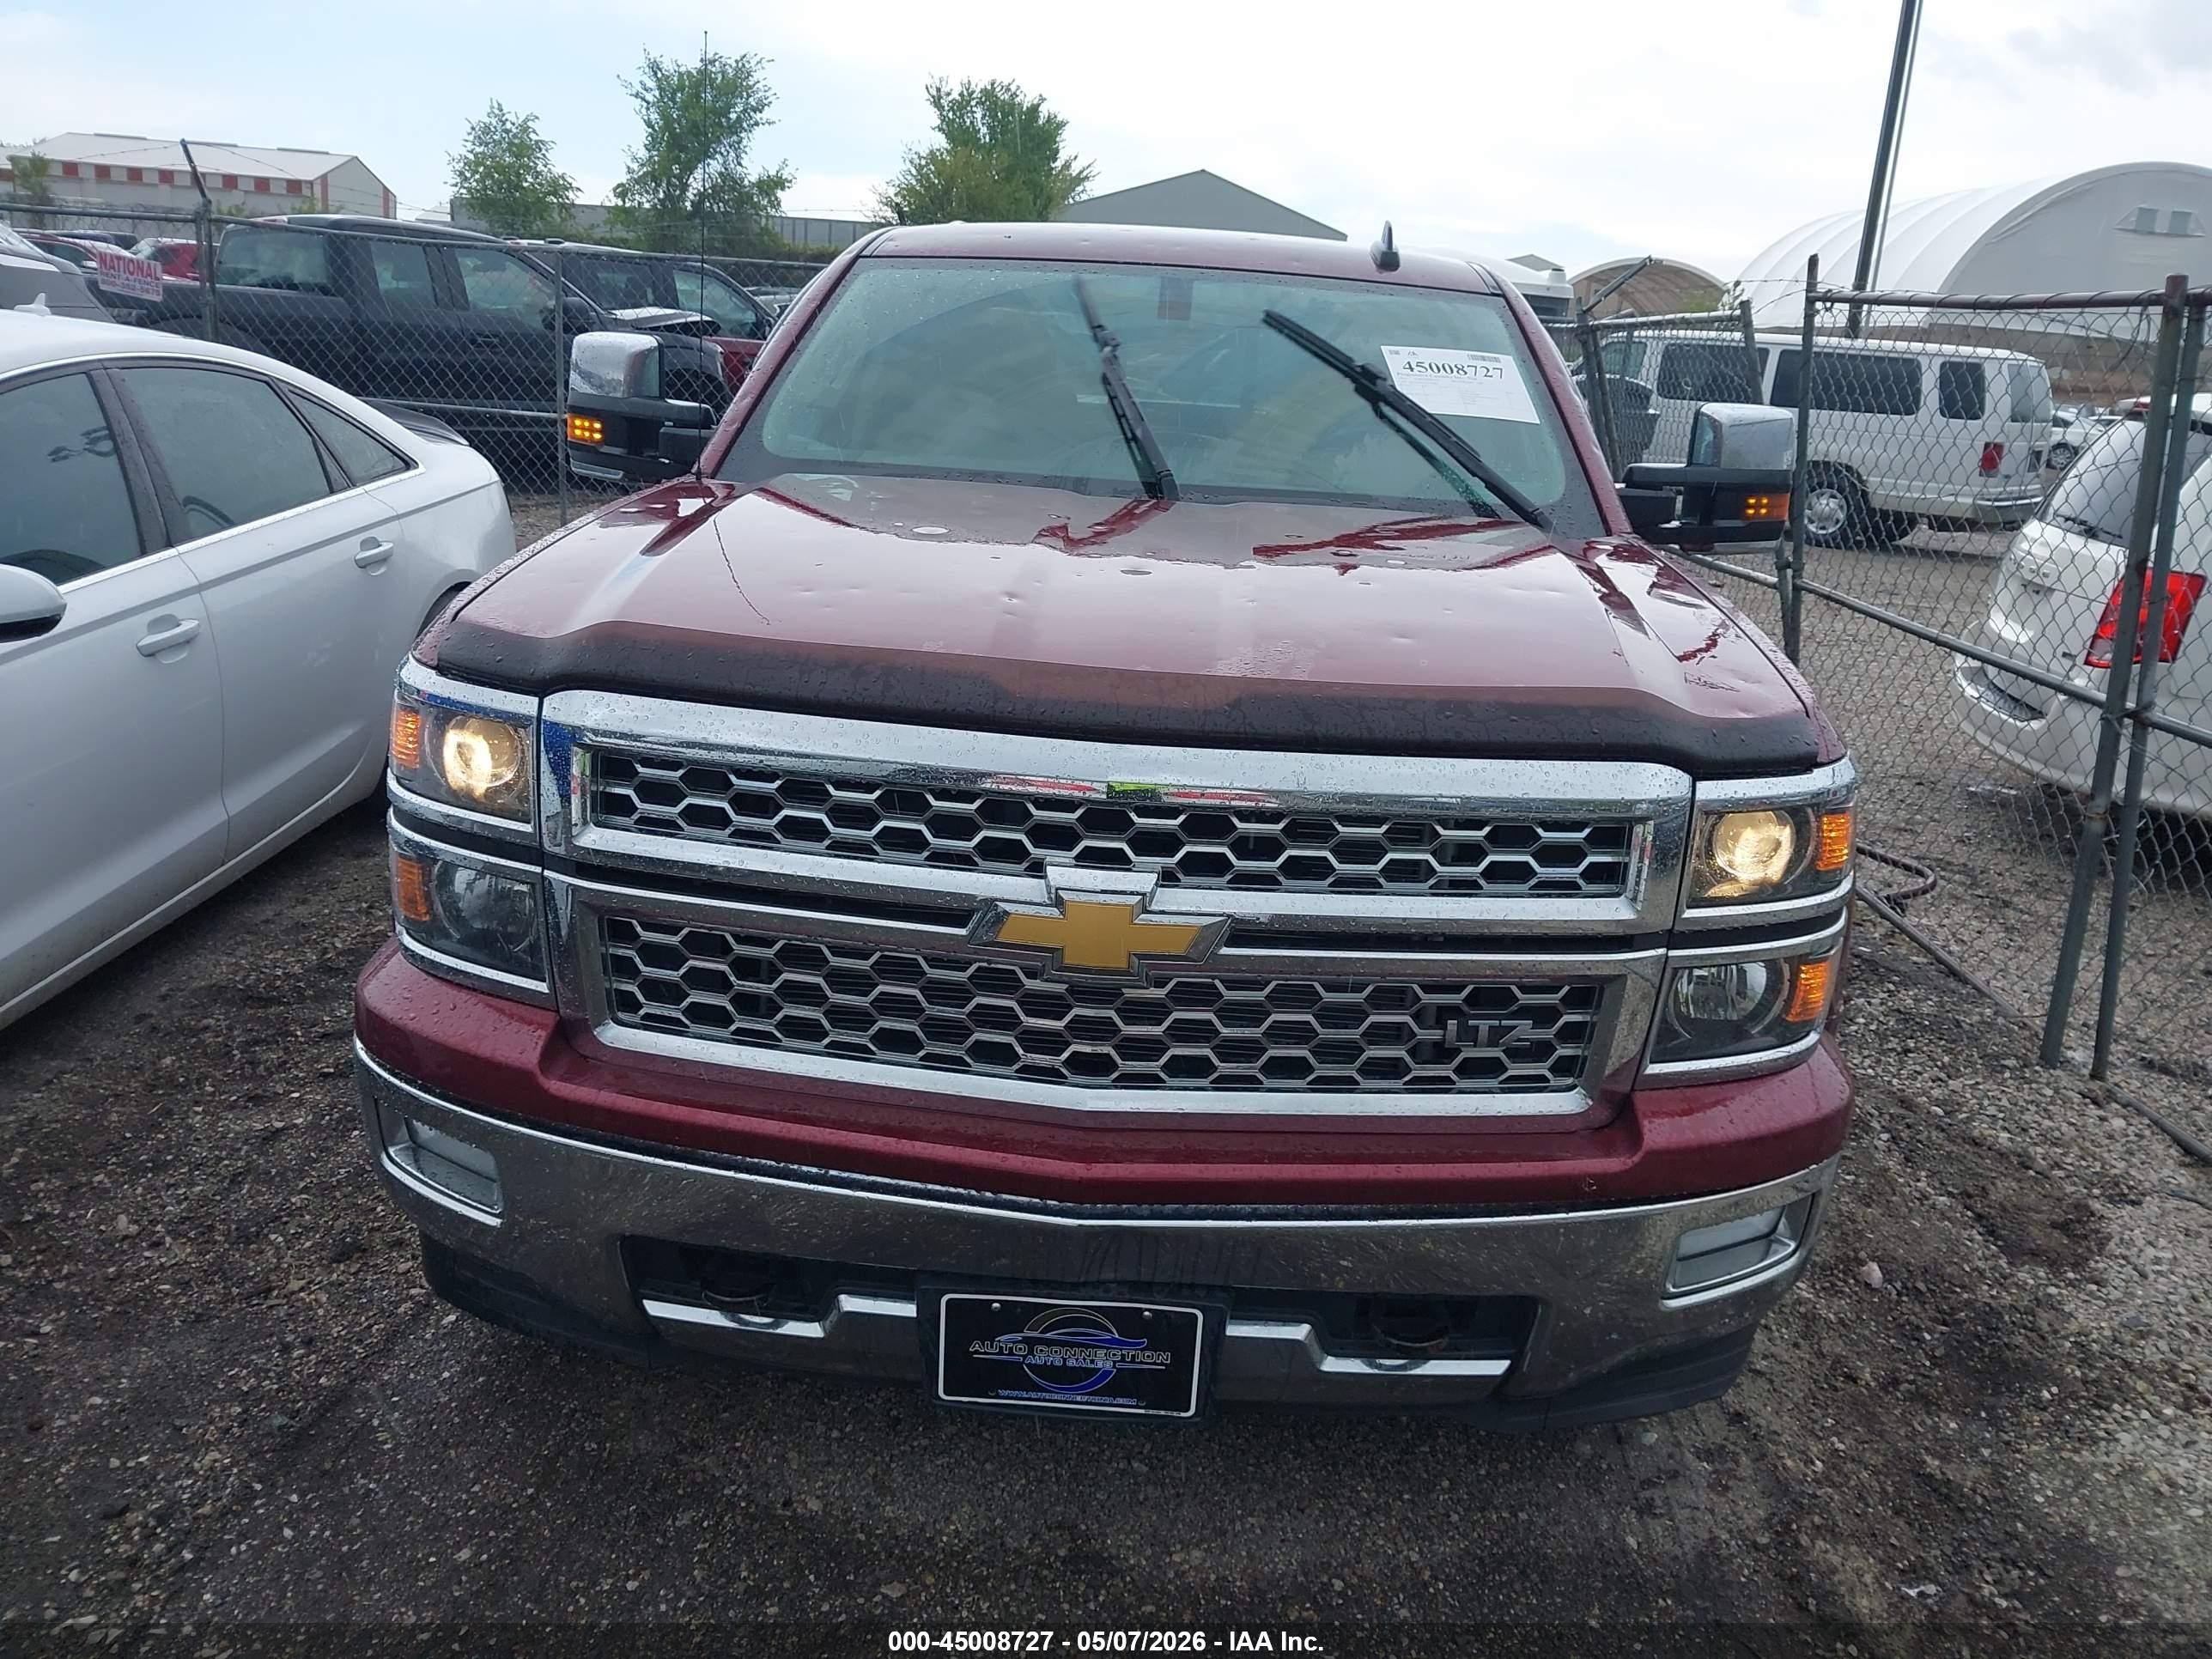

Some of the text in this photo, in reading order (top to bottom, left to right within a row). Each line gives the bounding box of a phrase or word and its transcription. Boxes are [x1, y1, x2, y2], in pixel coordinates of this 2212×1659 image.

[100, 252, 161, 282] NATIONAL
[1402, 361, 1504, 380] 45008727
[1444, 1019, 1533, 1048] LTZ
[969, 1340, 1171, 1364] AUTO CONNECTION
[1024, 1355, 1114, 1369] AUTO SALES
